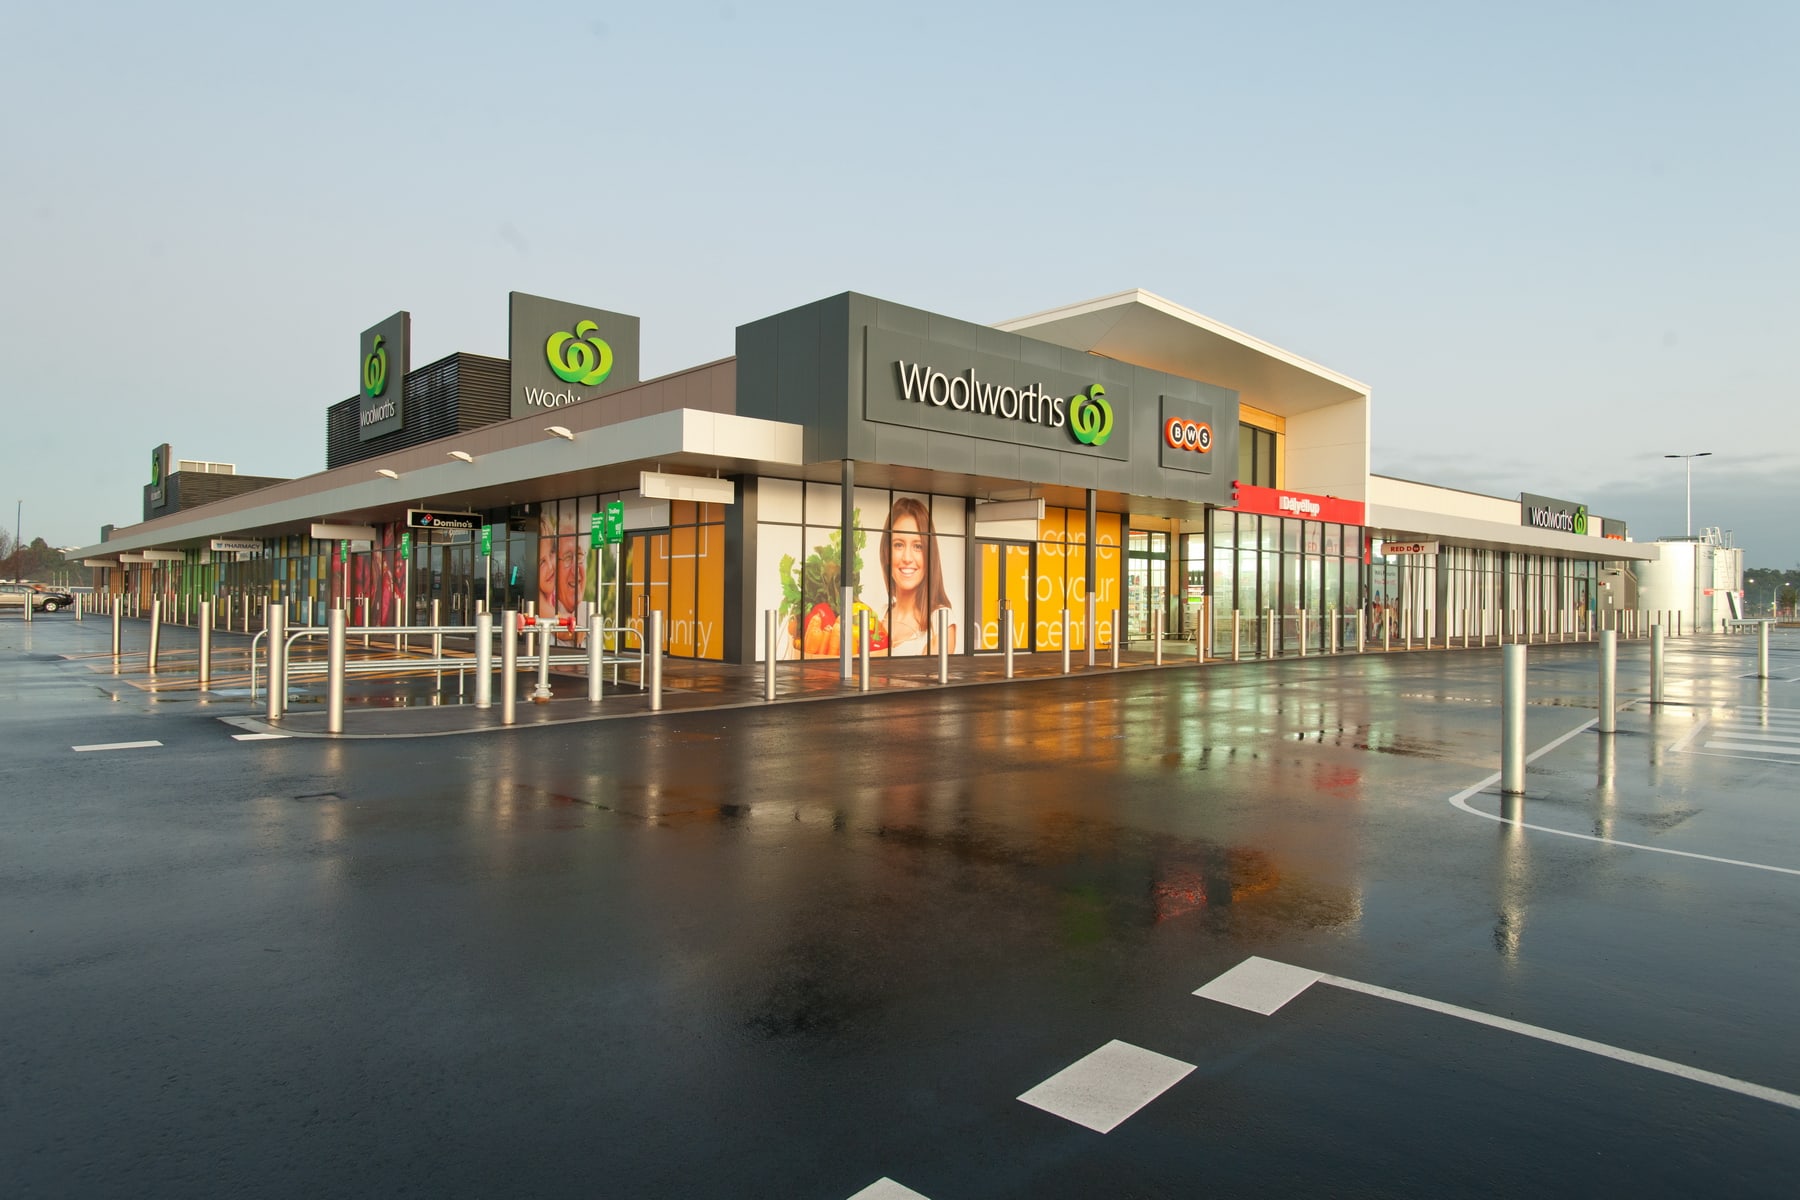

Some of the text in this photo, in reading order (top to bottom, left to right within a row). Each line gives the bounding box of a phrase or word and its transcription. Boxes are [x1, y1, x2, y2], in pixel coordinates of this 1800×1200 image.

[899, 359, 1066, 427] Woolworths
[360, 399, 396, 428] Woolworths
[433, 518, 473, 528] Domino's
[1531, 506, 1574, 532] Woolworths
[989, 529, 1114, 560] come
[1406, 544, 1425, 553] DOT
[1021, 568, 1053, 602] to
[603, 609, 713, 658] cmuniy
[1036, 615, 1112, 648] cente
